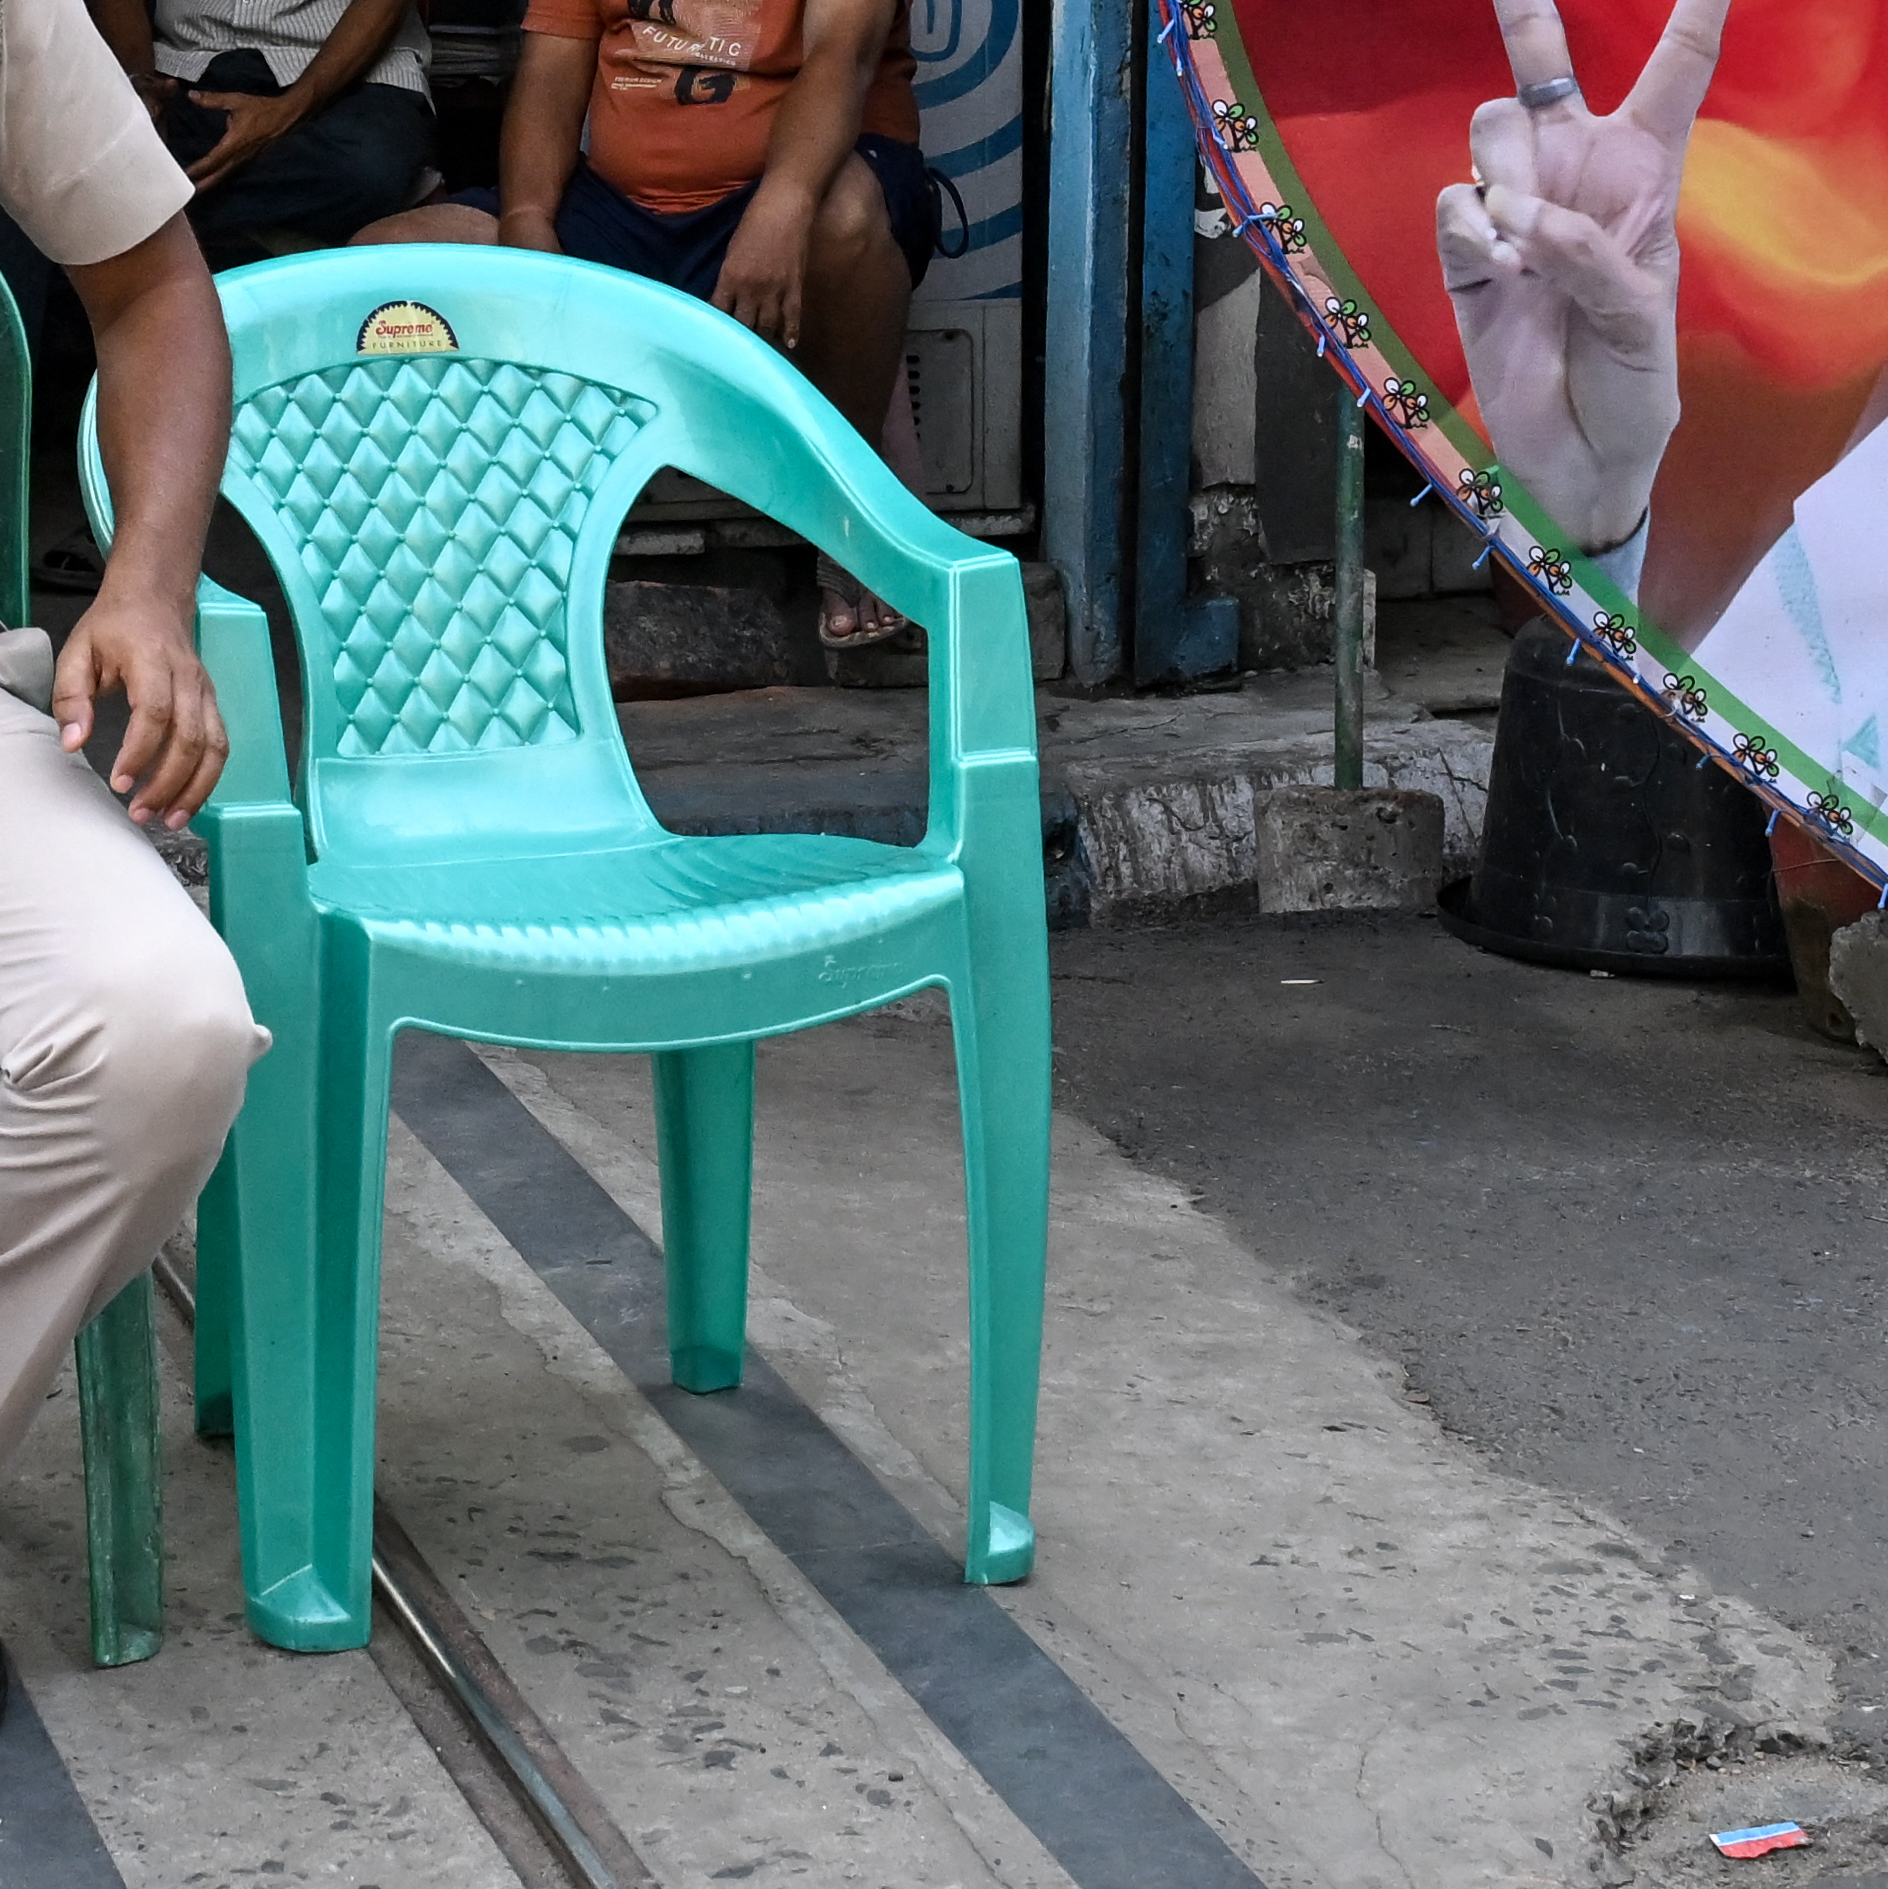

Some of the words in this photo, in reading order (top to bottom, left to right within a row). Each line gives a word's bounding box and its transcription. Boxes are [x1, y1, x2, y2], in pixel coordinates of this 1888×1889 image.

[642, 25, 742, 57] FUTURTIC
[375, 319, 434, 339] Supreme
[372, 339, 442, 349] FURNITURE
